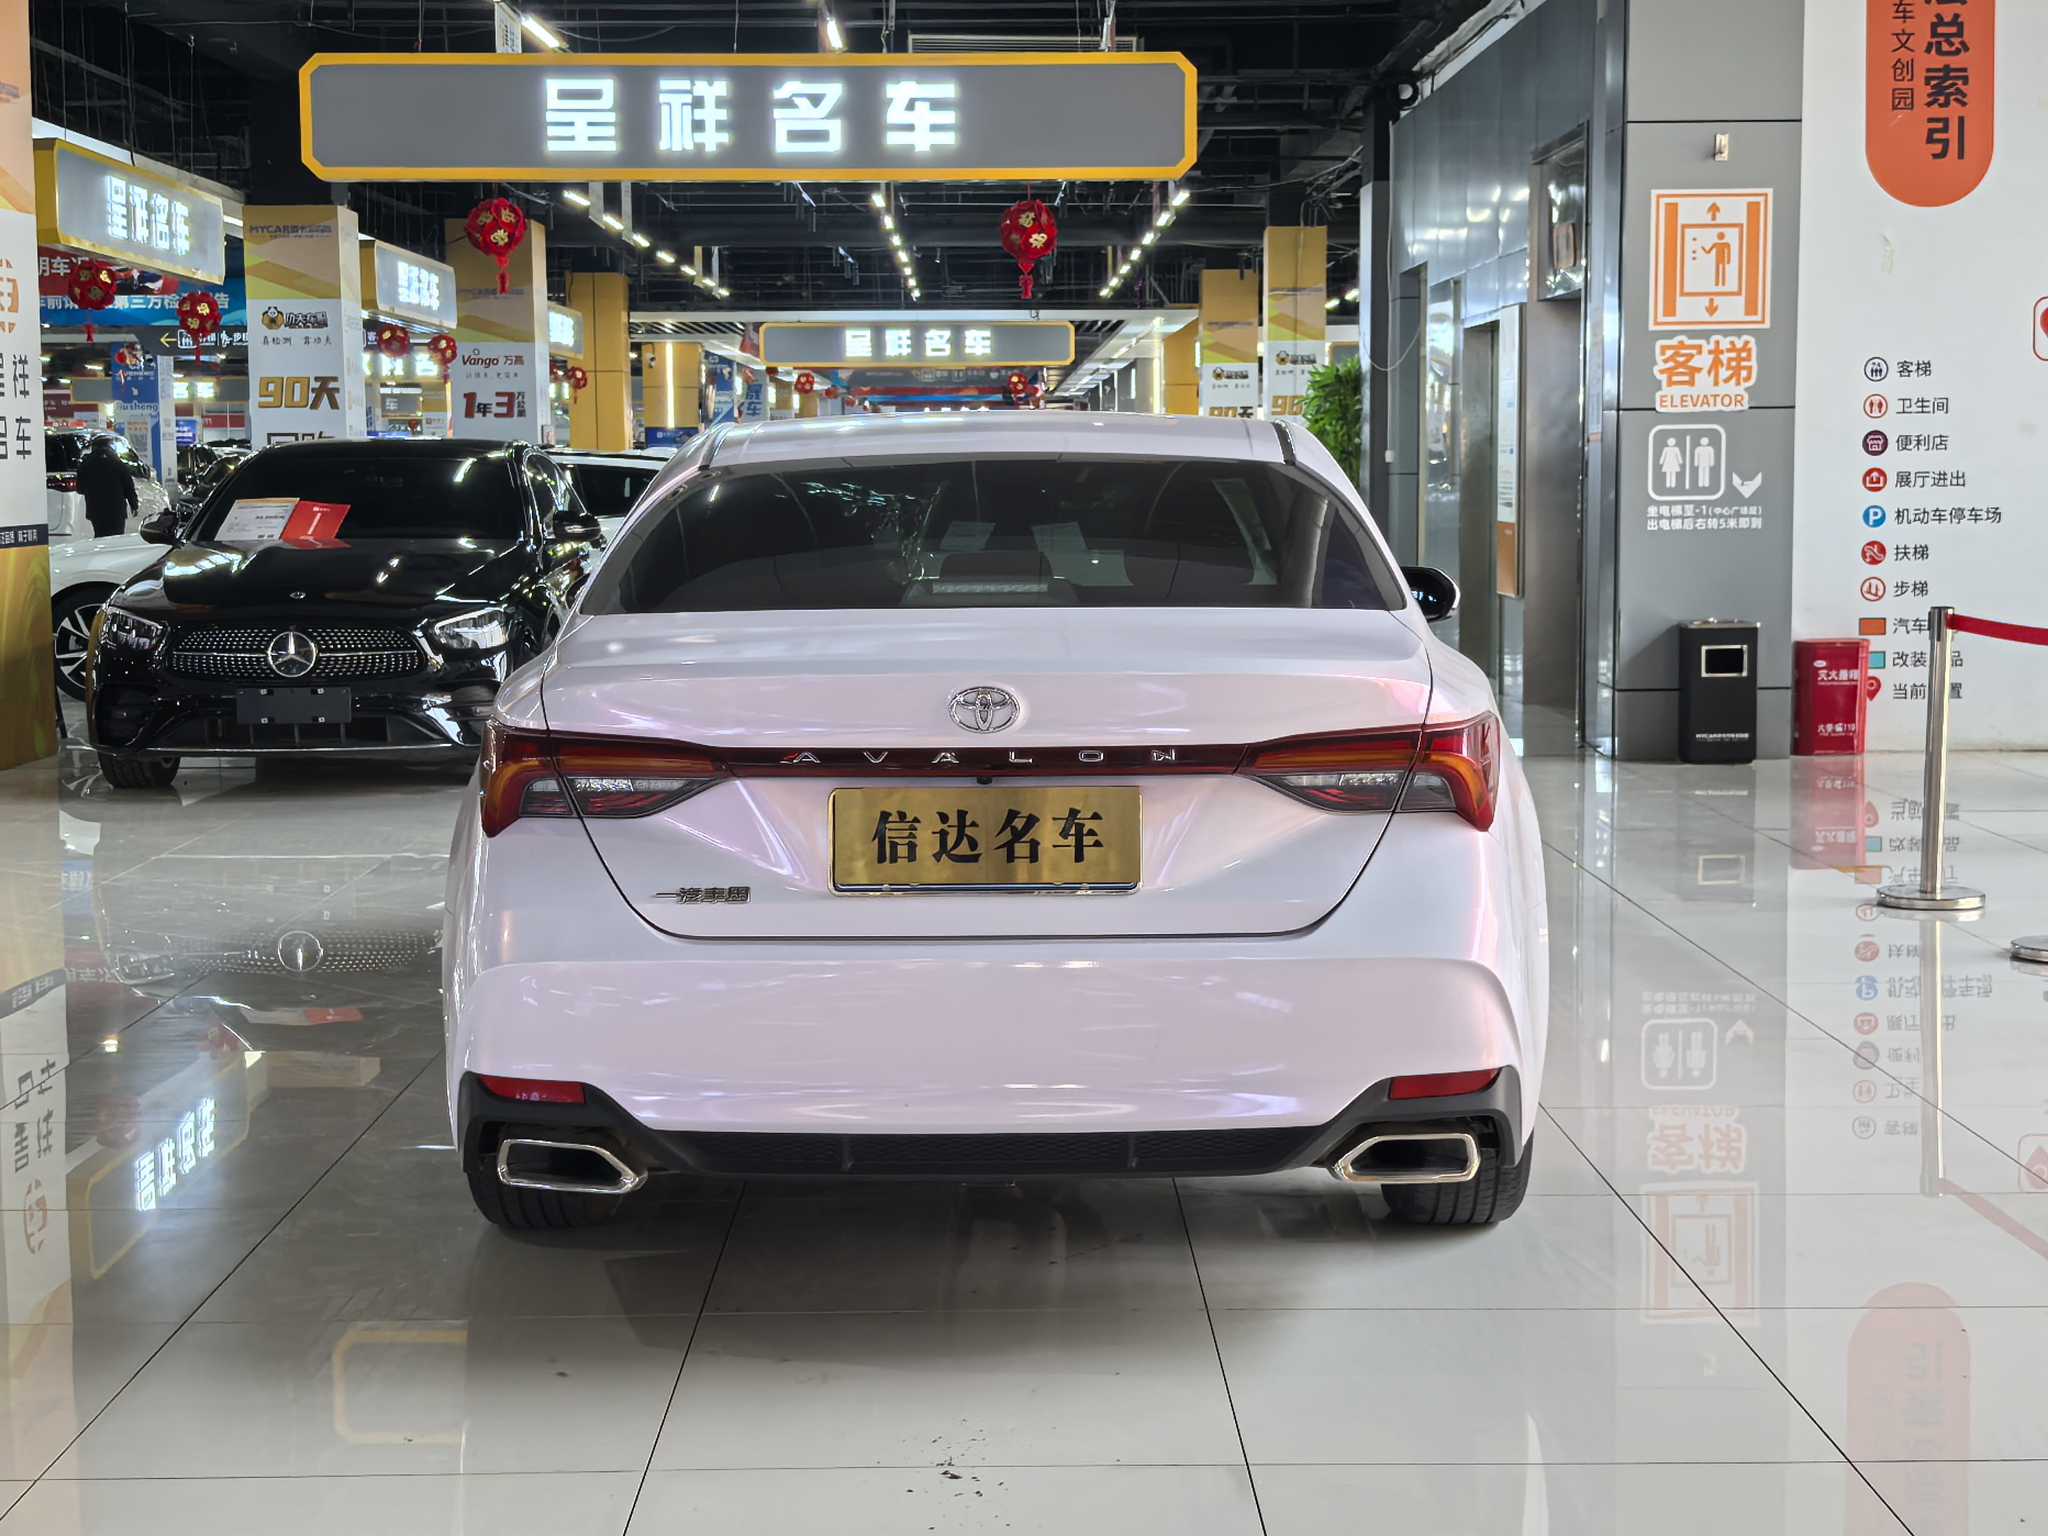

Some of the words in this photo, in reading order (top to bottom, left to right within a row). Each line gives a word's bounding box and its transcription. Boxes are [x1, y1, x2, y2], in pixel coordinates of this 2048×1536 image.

[1924, 0, 1970, 160] 总索引
[544, 78, 957, 152] 呈祥名车
[462, 352, 499, 368] Vango
[1658, 340, 1755, 387] 客梯
[1897, 360, 1931, 377] 客梯
[0, 354, 29, 398] 祥
[258, 376, 340, 410] 90天
[1659, 394, 1744, 408] ELEVATOR
[1896, 397, 1949, 414] 卫生间
[1896, 434, 1949, 451] 便利店
[1895, 470, 1966, 488] 展厅进出
[1895, 507, 2001, 525] 机动车停车场
[1894, 544, 1929, 561] 扶梯
[1893, 580, 1929, 597] 步梯
[1892, 651, 1963, 668] 改装品
[1893, 683, 1962, 700] 当前置
[791, 750, 1177, 765] AVALON
[872, 808, 1104, 864] 信达名车
